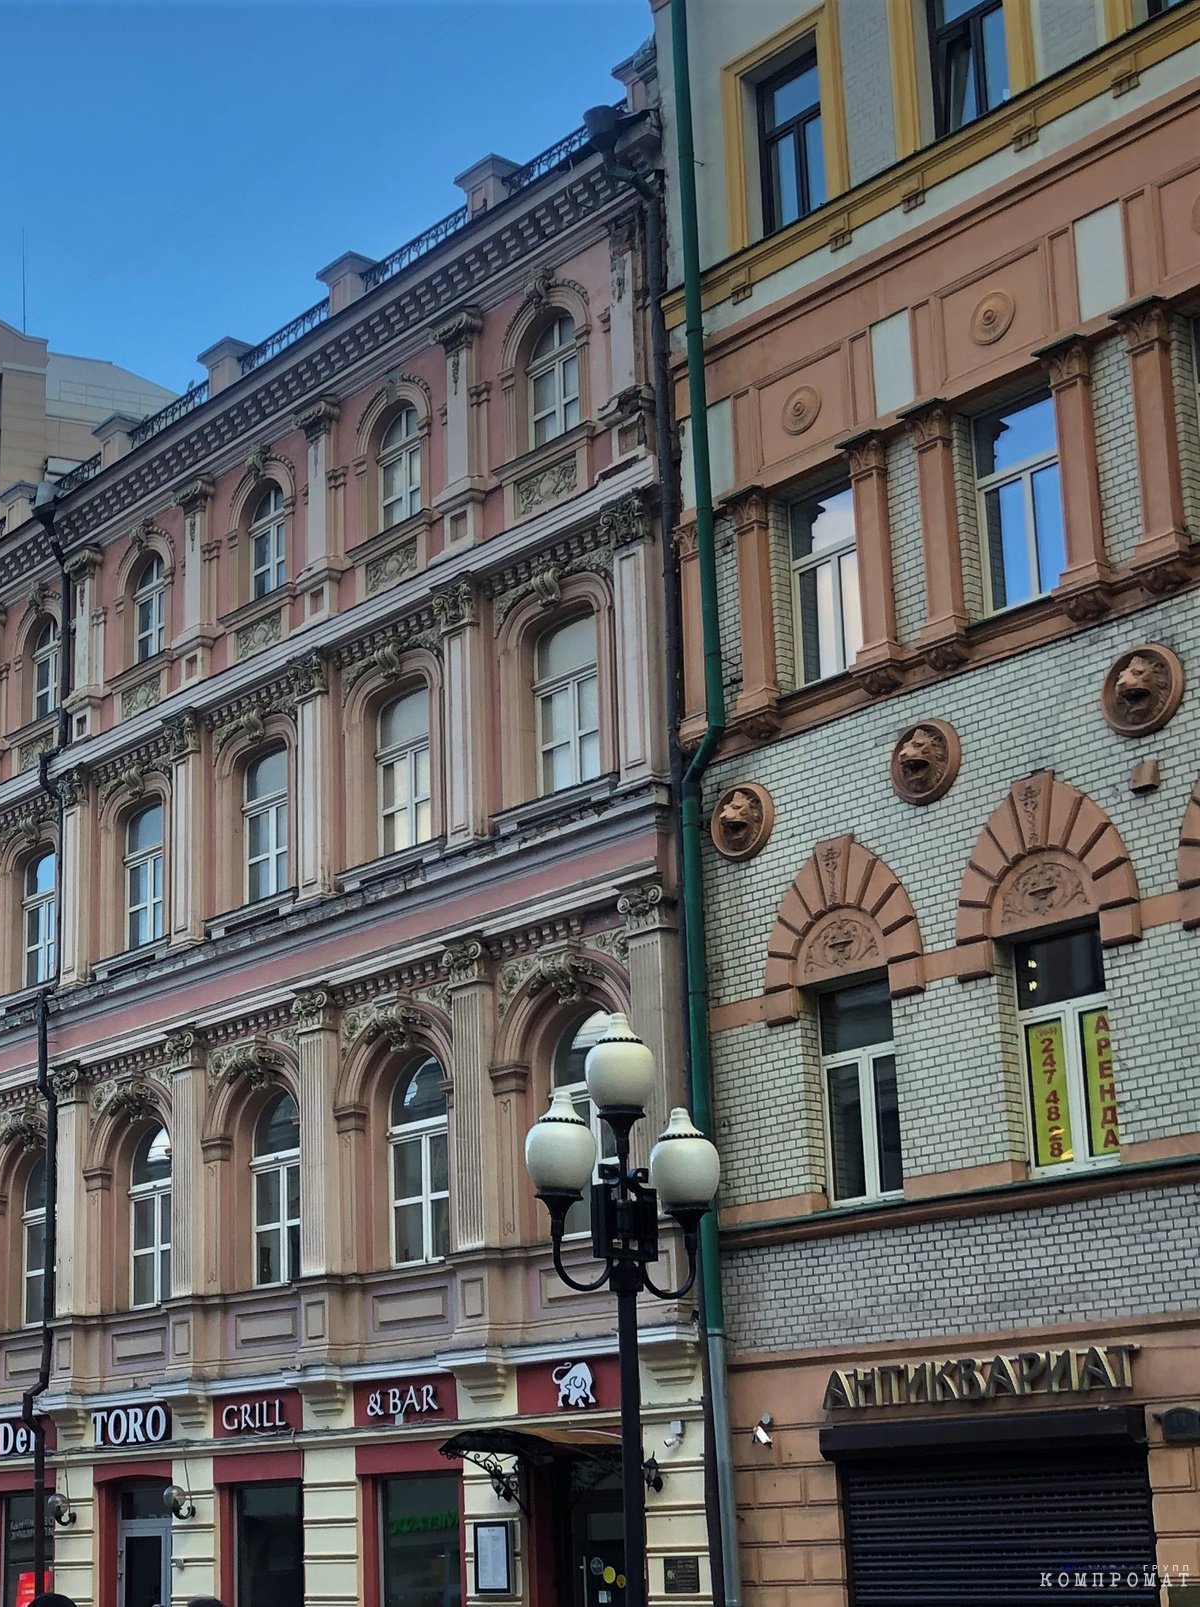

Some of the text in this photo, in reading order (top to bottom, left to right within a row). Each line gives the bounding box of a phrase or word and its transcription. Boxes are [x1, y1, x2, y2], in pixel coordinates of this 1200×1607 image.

[1040, 1037, 1057, 1085] 247
[1094, 1014, 1119, 1148] АРЕНДА
[823, 1343, 1141, 1410] АНТИКВАРИАТ
[222, 1399, 286, 1431] GRILL
[366, 1384, 438, 1416] & BAR
[91, 1405, 166, 1446] TORO
